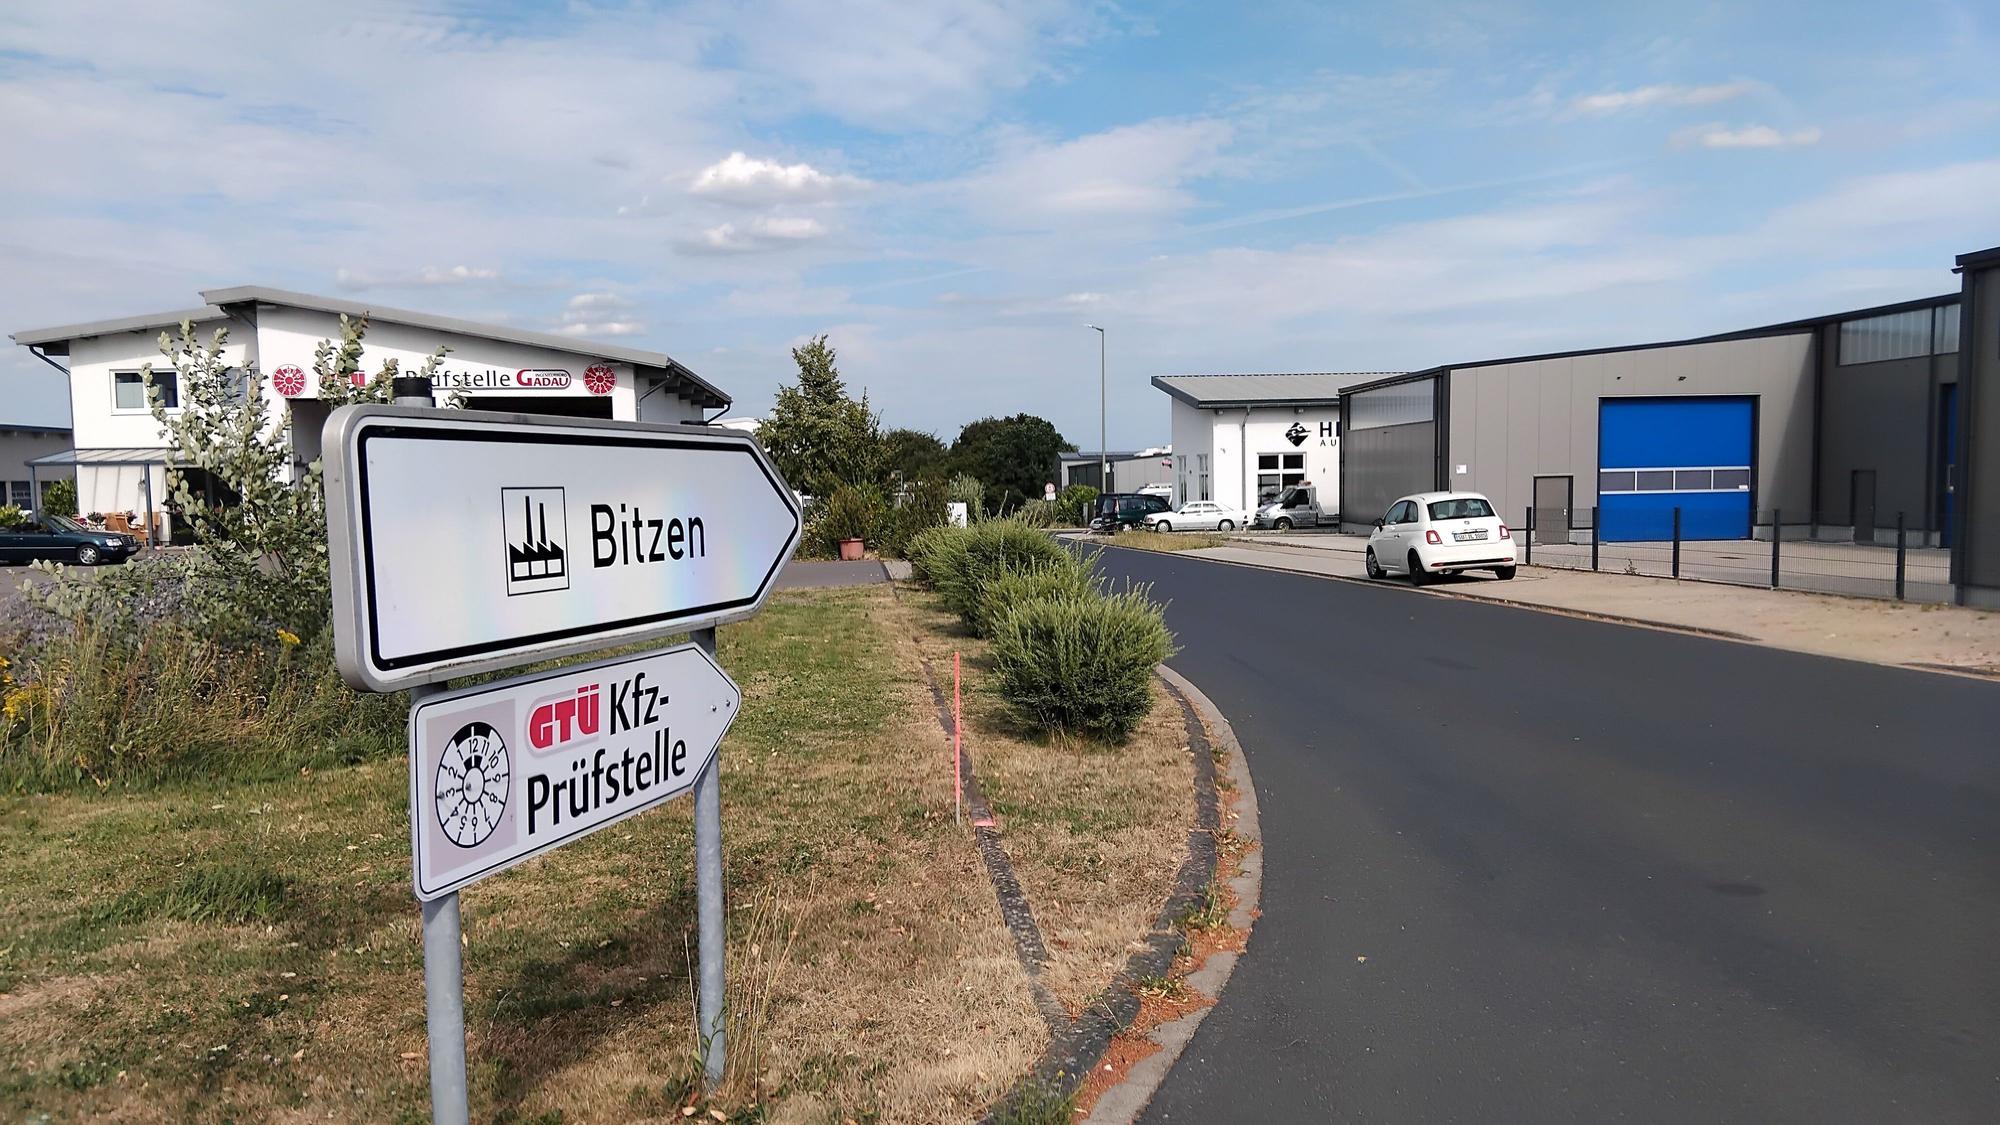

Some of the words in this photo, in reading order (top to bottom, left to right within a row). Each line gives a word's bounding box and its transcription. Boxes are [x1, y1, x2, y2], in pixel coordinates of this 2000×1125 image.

[516, 369, 569, 386] GADAU
[591, 503, 706, 568] Bitzen
[530, 684, 600, 750] GTÜ
[610, 672, 670, 736] Kfz-
[468, 738, 478, 754] 12
[488, 750, 499, 768] 10
[448, 766, 458, 779] 2
[527, 727, 687, 835] Prüfstelle
[446, 787, 455, 797] 3
